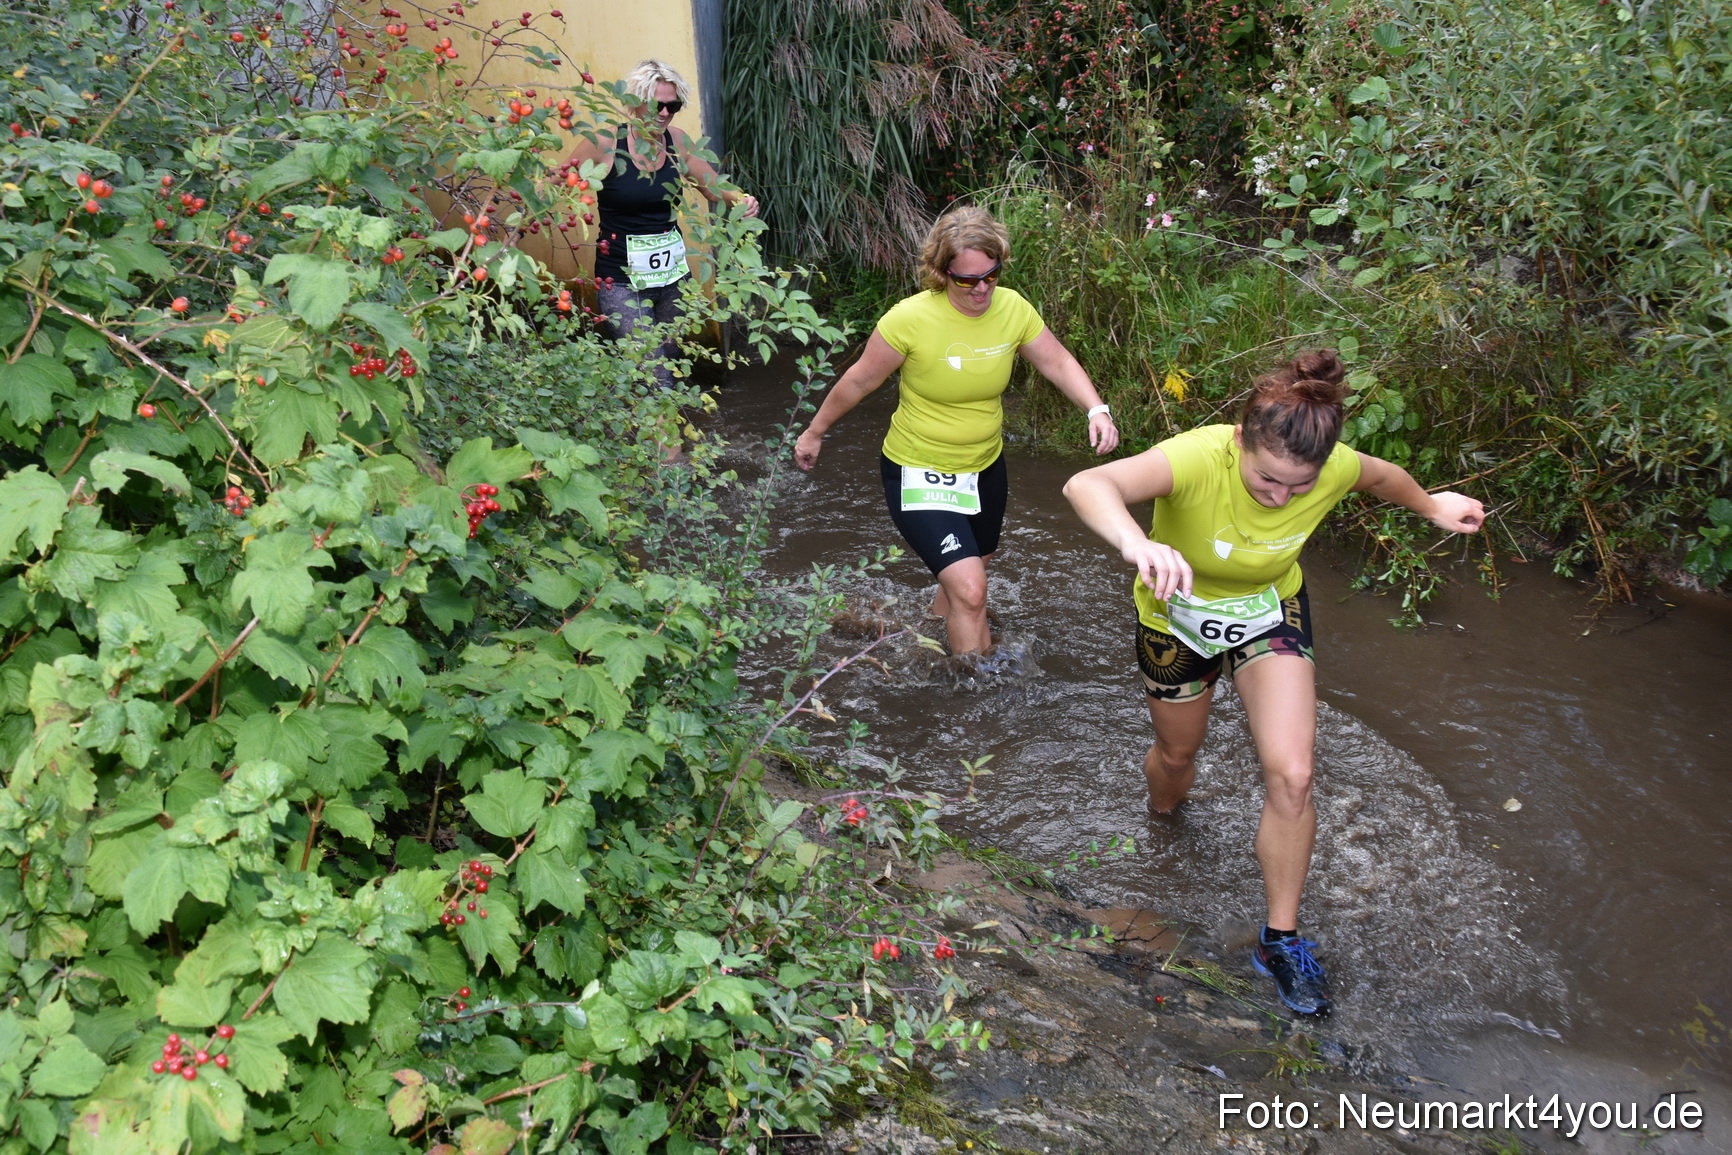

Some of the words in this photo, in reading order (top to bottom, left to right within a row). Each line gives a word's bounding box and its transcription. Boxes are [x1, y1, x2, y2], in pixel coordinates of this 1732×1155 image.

[649, 250, 671, 270] 67
[924, 471, 957, 486] 69
[922, 491, 959, 504] JULIA
[1199, 619, 1248, 644] 66
